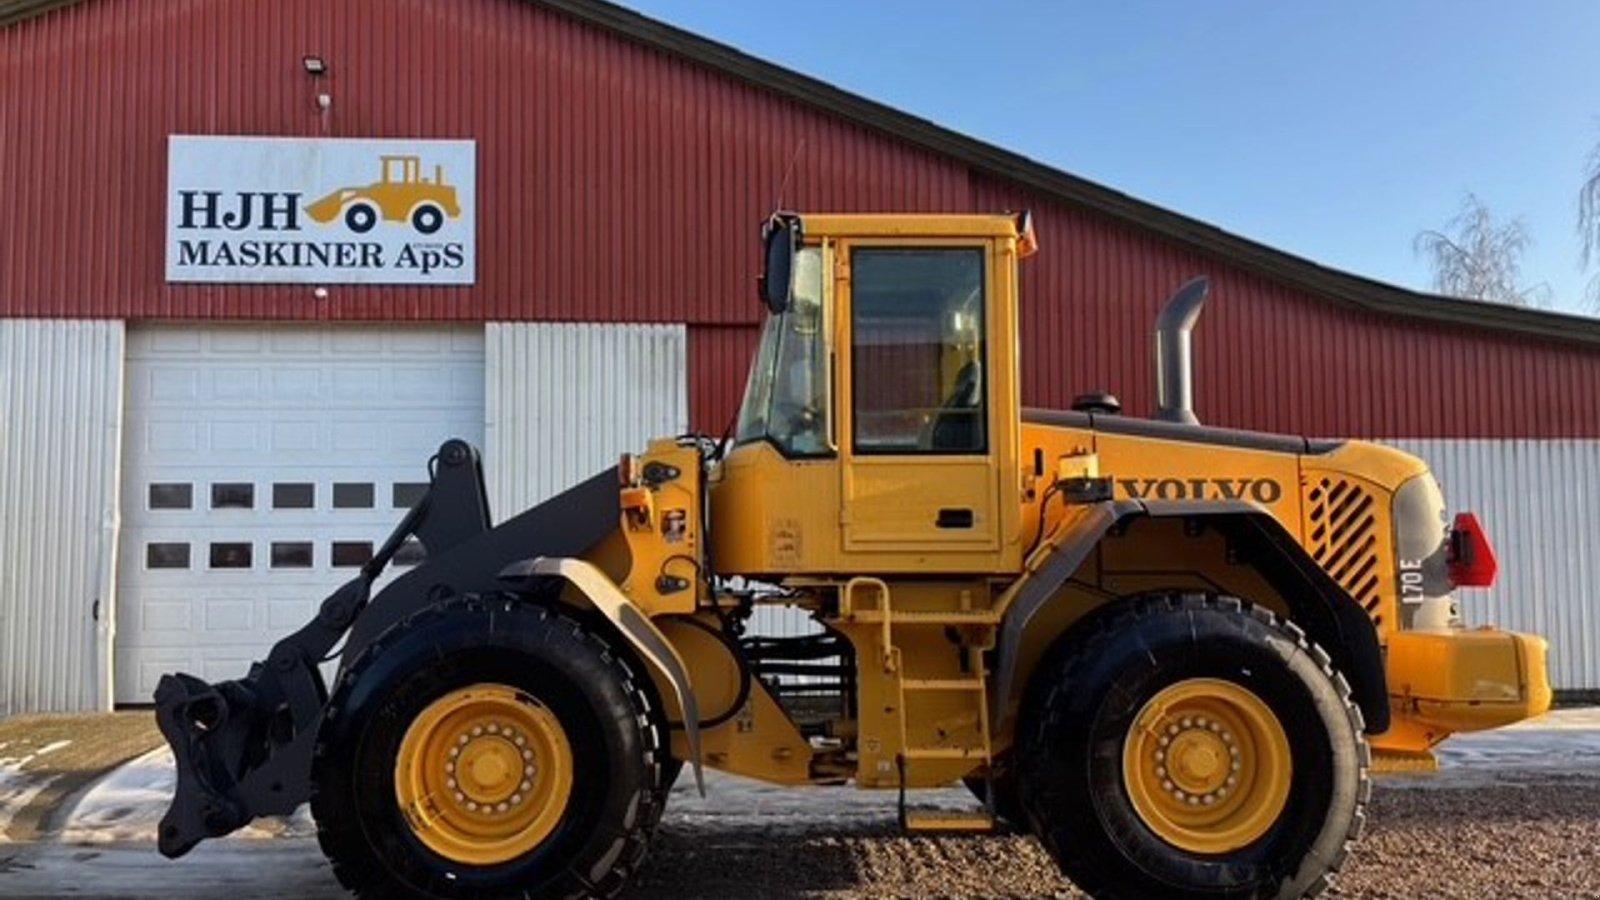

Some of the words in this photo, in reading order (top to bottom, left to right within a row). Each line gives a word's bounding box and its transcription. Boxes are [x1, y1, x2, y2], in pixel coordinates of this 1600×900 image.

[178, 191, 302, 231] HJH
[178, 240, 386, 268] MASKINER
[393, 242, 465, 274] ApS
[1116, 477, 1282, 504] VOLVO
